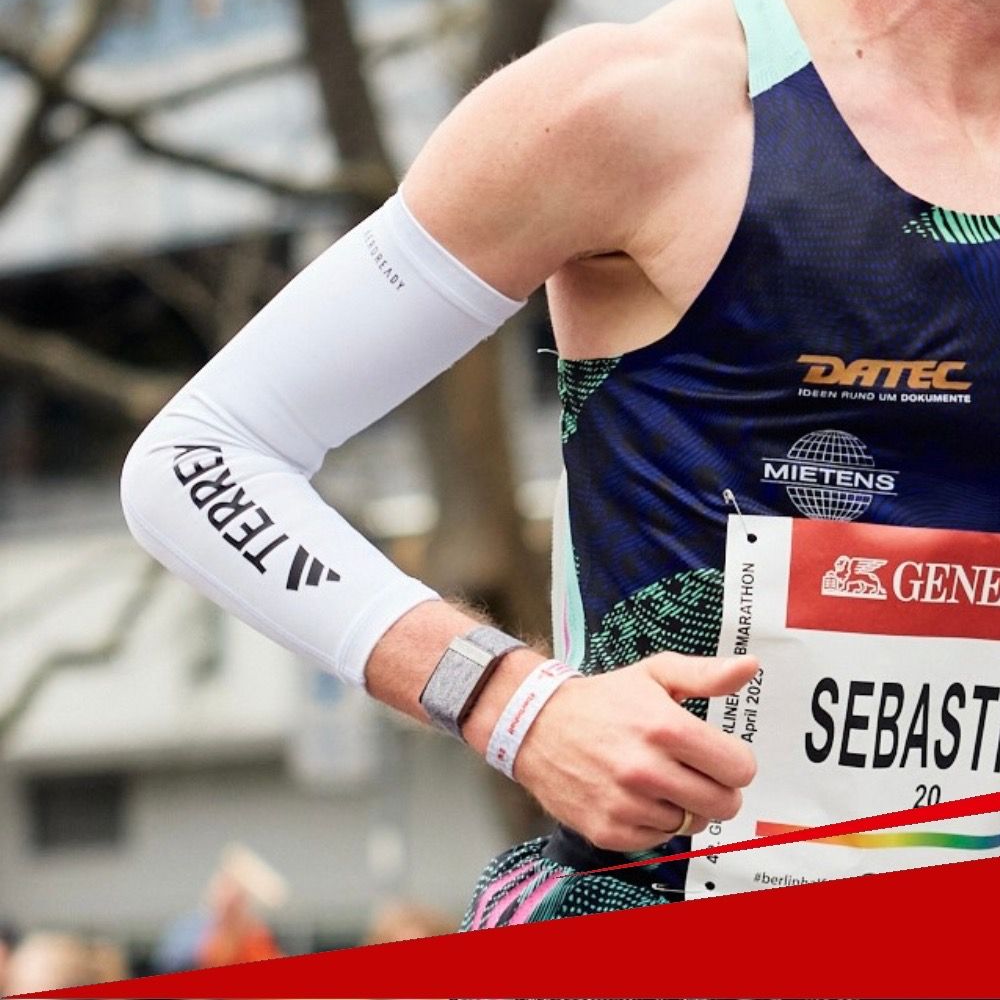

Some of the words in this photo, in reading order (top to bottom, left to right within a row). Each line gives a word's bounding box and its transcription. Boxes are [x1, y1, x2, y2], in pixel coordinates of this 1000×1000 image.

[796, 355, 973, 390] DATEC
[798, 388, 838, 399] IDEEN
[841, 391, 875, 401] RUND
[879, 393, 897, 401] UM
[901, 394, 971, 403] DOKUMENTE
[764, 463, 895, 491] MIETENS
[741, 709, 758, 743] April
